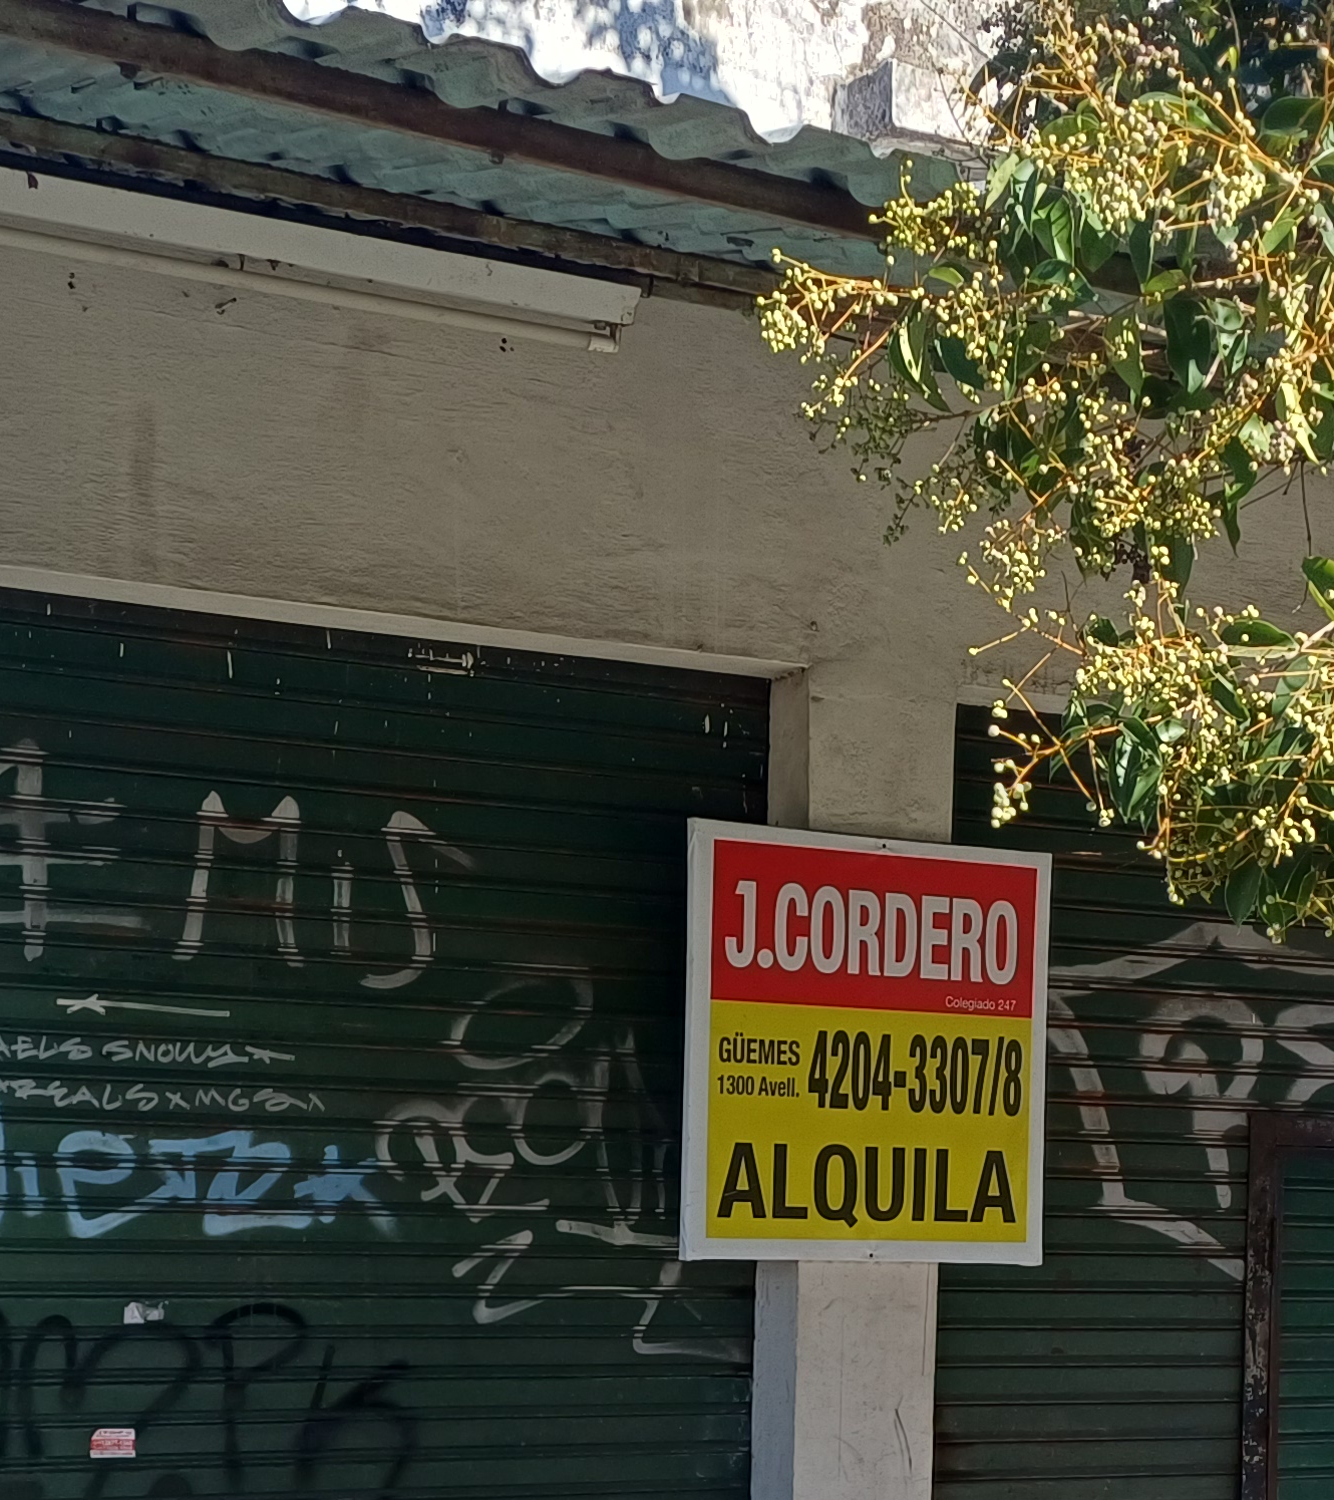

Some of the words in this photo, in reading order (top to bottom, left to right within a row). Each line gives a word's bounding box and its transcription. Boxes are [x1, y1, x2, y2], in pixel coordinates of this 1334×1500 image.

[724, 879, 1019, 986] J.CORDERO
[945, 995, 996, 1011] Colegiado
[998, 999, 1017, 1012] 247
[718, 1032, 801, 1067] GÜEMES
[808, 1029, 1023, 1117] 4204-3307/8
[717, 1074, 755, 1096] 1300
[758, 1077, 800, 1098] Avell.
[716, 1142, 1017, 1229] ALQUILA
